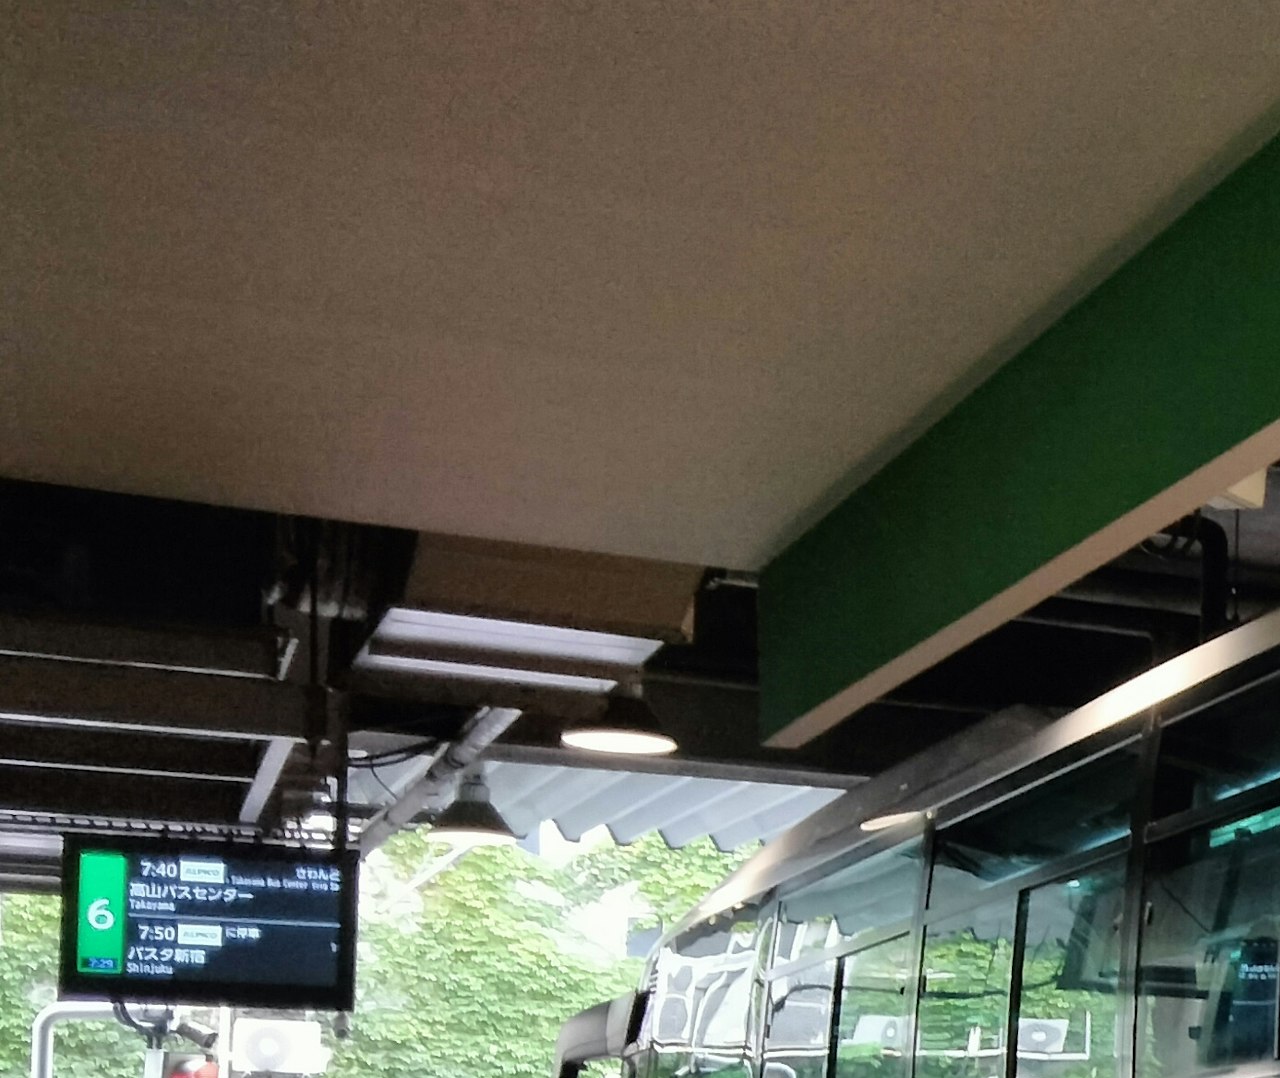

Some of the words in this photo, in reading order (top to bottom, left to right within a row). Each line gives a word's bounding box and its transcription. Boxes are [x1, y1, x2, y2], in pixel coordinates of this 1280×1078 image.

[140, 859, 178, 878] 7:40
[129, 882, 254, 902] 高山バスセンター
[87, 898, 115, 930] 6
[129, 898, 176, 912] Takayama
[138, 924, 176, 942] 7:50
[127, 945, 206, 964] バスタ新宿
[126, 962, 174, 976] Shinjuku
